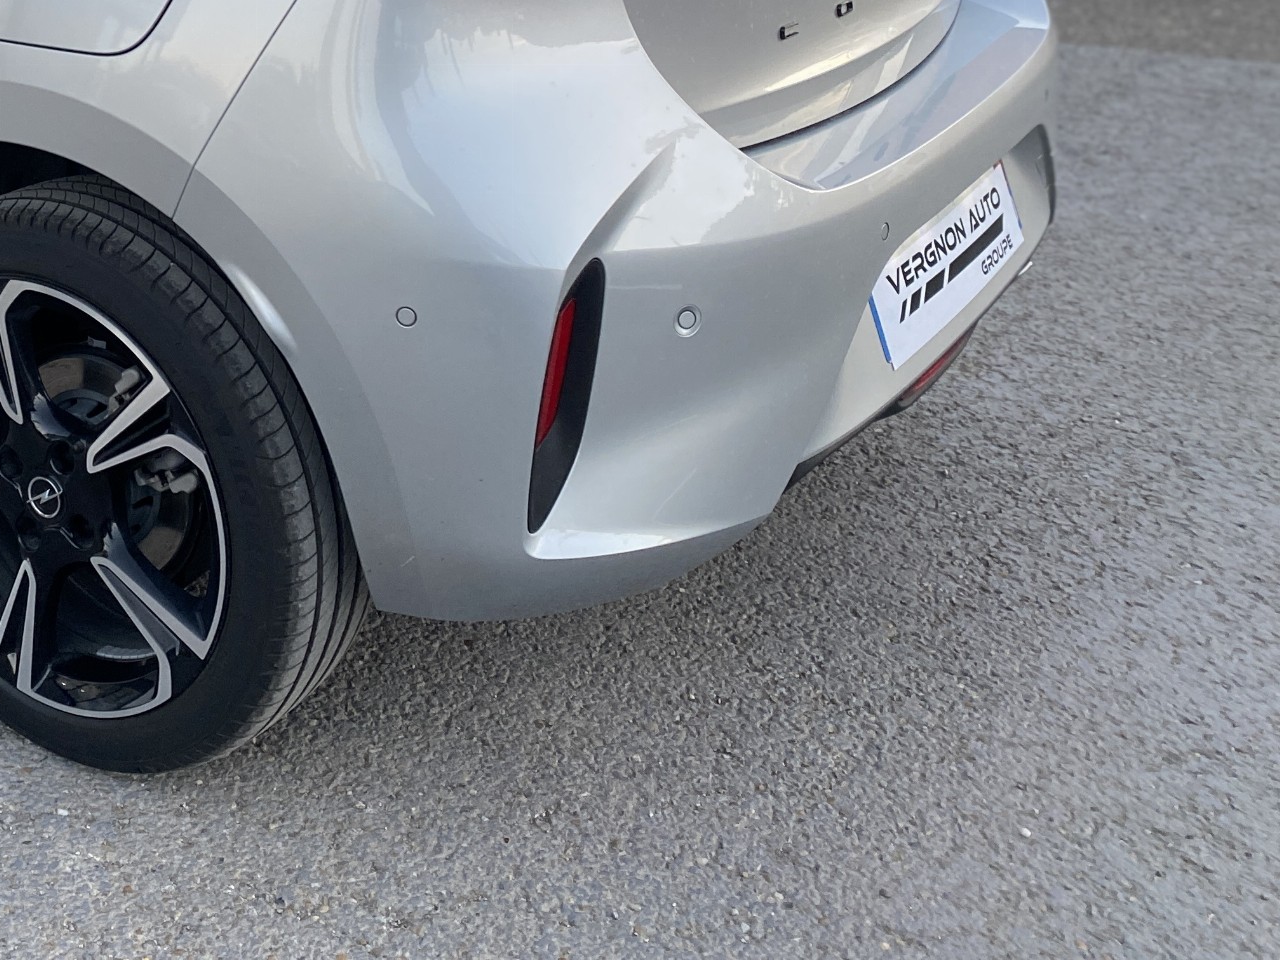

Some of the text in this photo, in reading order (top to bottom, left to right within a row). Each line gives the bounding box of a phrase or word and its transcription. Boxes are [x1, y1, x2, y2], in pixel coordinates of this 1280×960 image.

[885, 186, 1001, 296] VERGNON AUTO
[980, 233, 1014, 276] GROUPE
